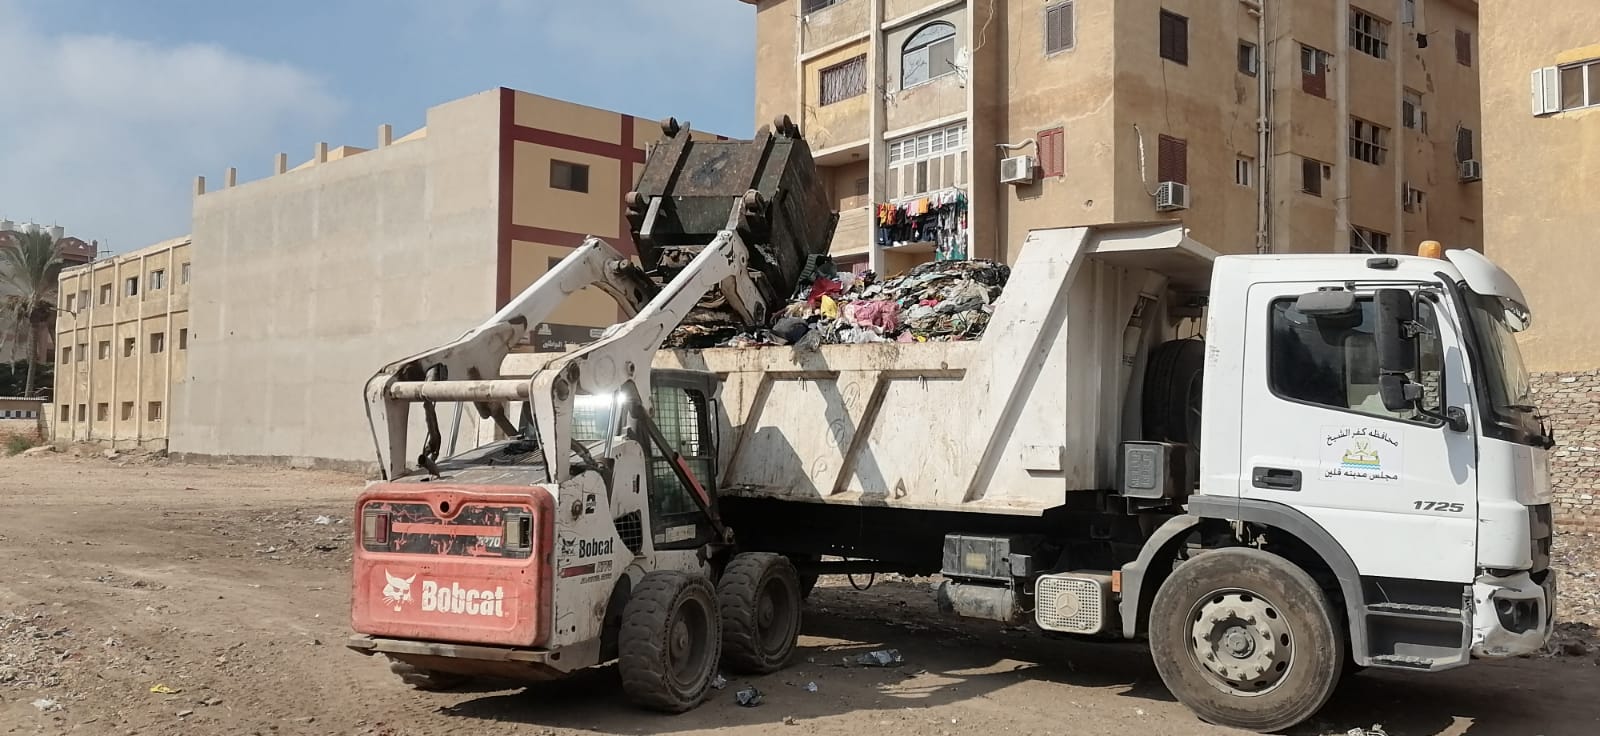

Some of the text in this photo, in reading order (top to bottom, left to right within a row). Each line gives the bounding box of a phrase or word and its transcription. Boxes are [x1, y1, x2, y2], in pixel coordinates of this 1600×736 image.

[1326, 428, 1351, 446] الشيخ
[1351, 427, 1368, 439] كفر
[1324, 468, 1342, 478] قلين
[1369, 471, 1398, 481] مجلس
[1413, 500, 1465, 513] 1725
[579, 536, 613, 558] Bobcat
[421, 580, 504, 617] Bobcat
